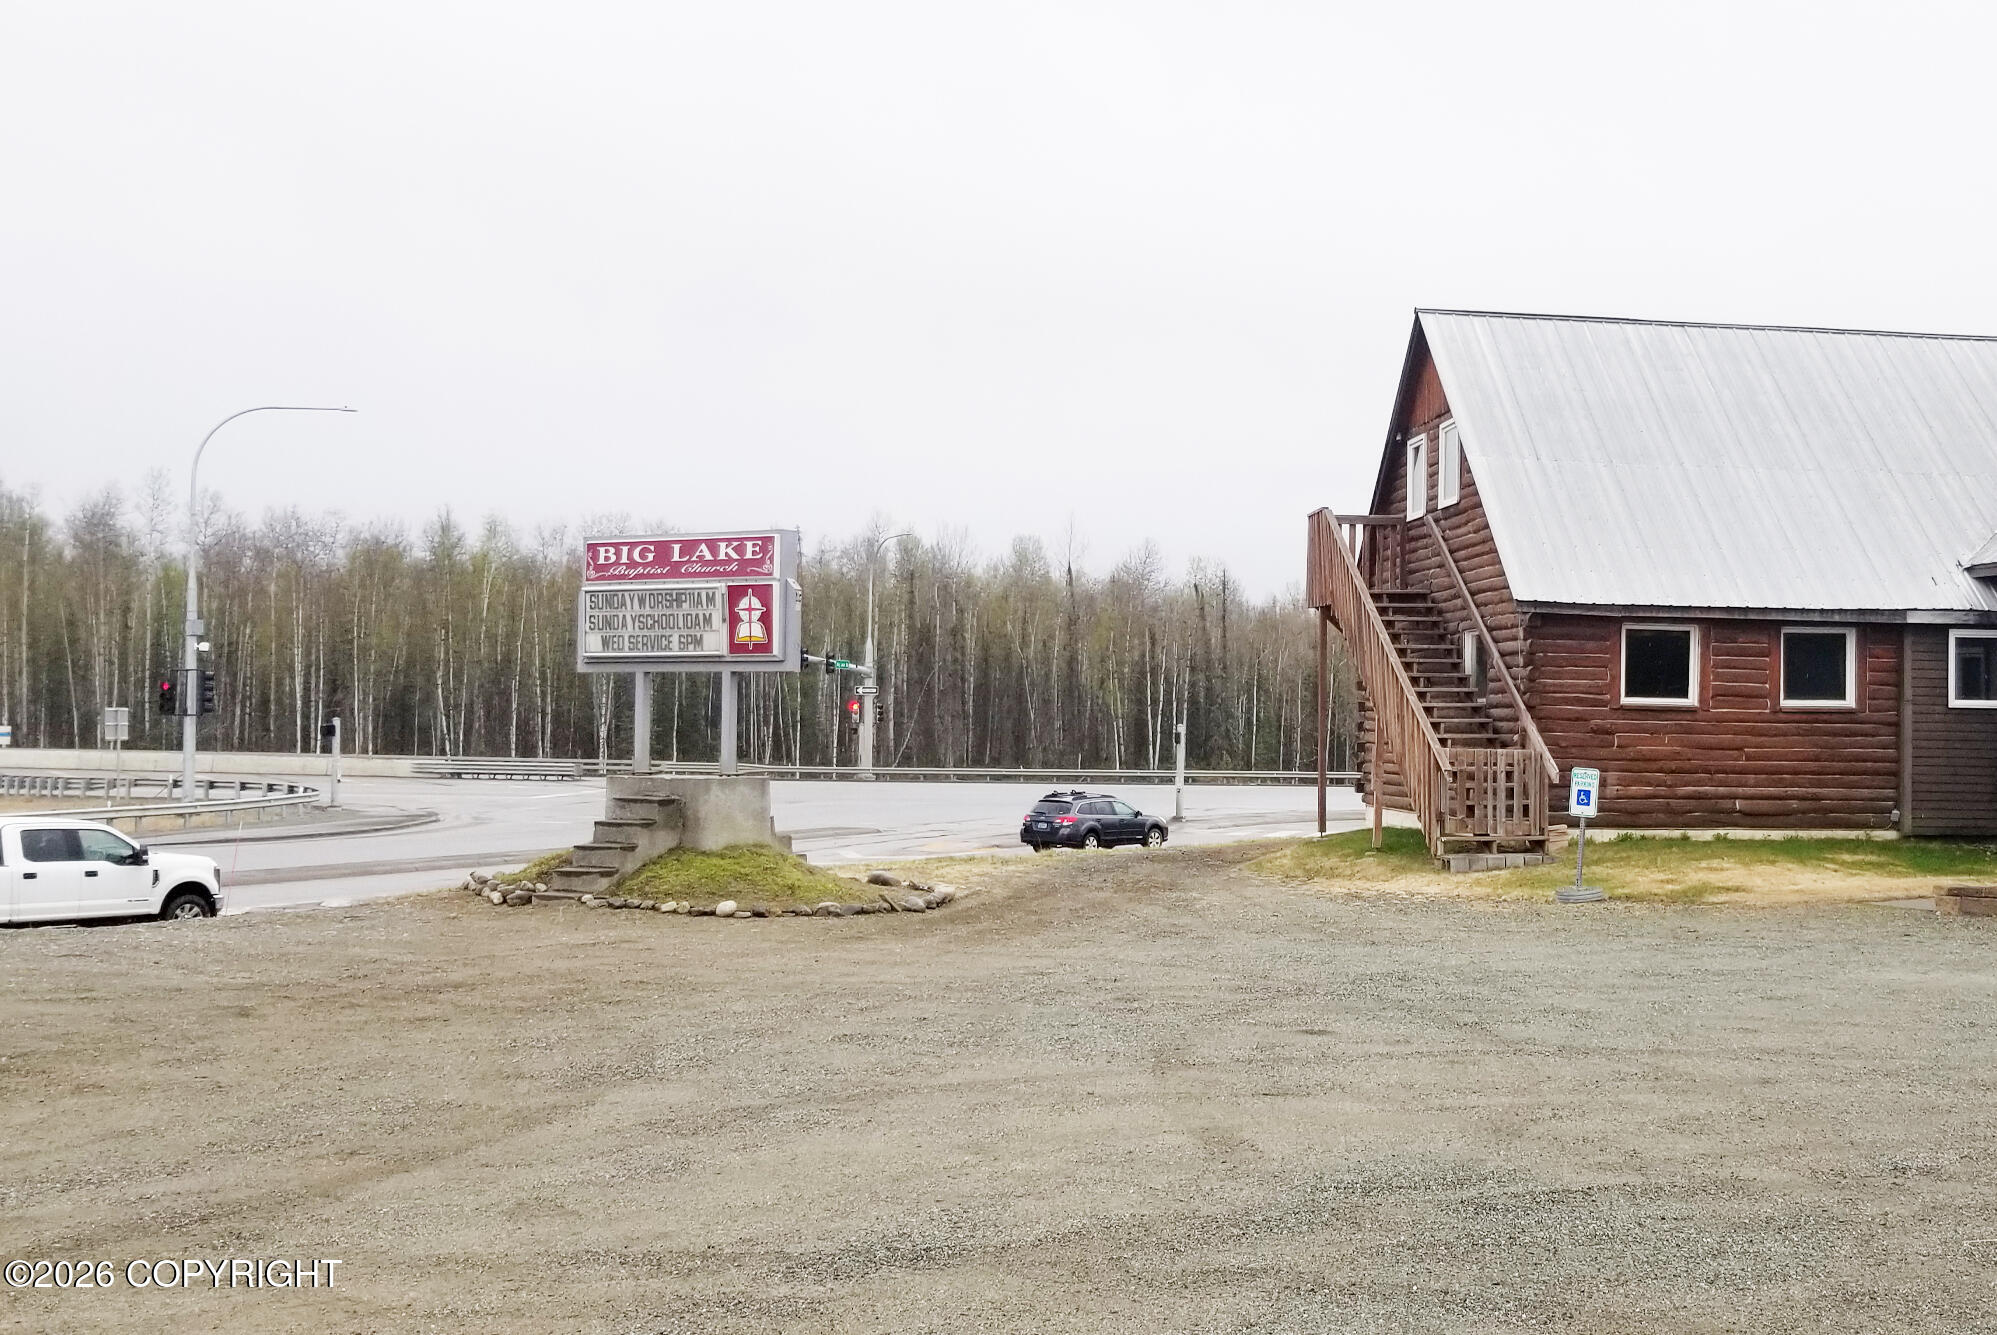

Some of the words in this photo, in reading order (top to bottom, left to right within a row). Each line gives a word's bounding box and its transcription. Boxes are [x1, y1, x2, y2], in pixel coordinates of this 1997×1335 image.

[596, 545, 656, 564] BIG
[671, 541, 763, 562] LAKE
[608, 564, 670, 578] Baptist
[681, 561, 739, 574] Church
[589, 593, 635, 610] SUNDAY
[588, 614, 636, 631] SUNDAY
[637, 613, 681, 630] SCHOOL
[600, 635, 625, 651] WED
[628, 635, 673, 651] SERVICE
[678, 634, 704, 651] 6PM
